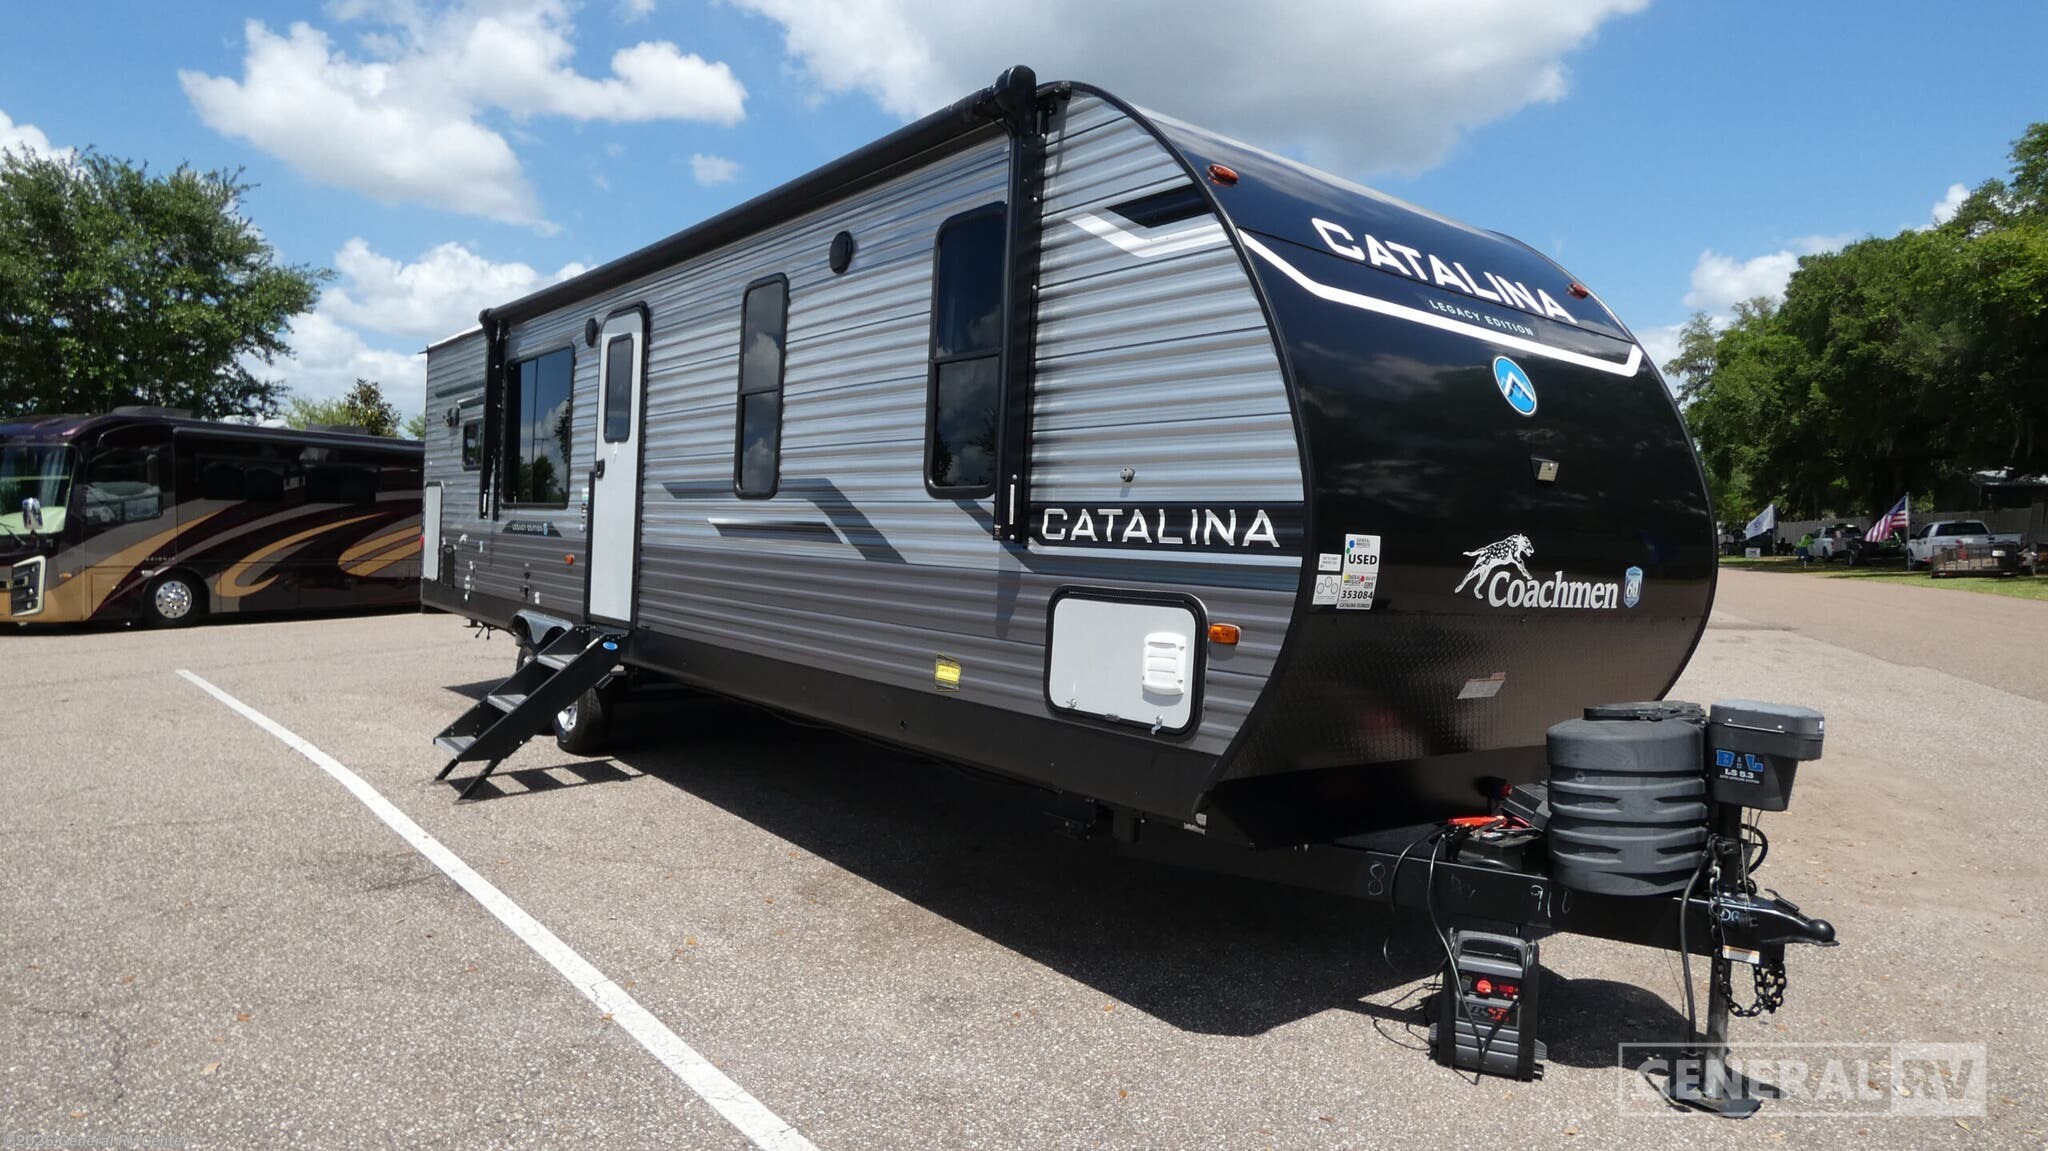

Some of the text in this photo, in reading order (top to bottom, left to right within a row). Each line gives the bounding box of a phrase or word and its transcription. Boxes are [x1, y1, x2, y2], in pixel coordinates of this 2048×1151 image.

[1312, 217, 1579, 324] CATALINA
[1429, 300, 1534, 337] LEGACY EDITION
[1042, 508, 1280, 548] CATALINA
[1348, 554, 1378, 565] USED
[1341, 590, 1373, 600] 353084
[1488, 570, 1619, 609] Coachmen
[1724, 768, 1738, 777] LS
